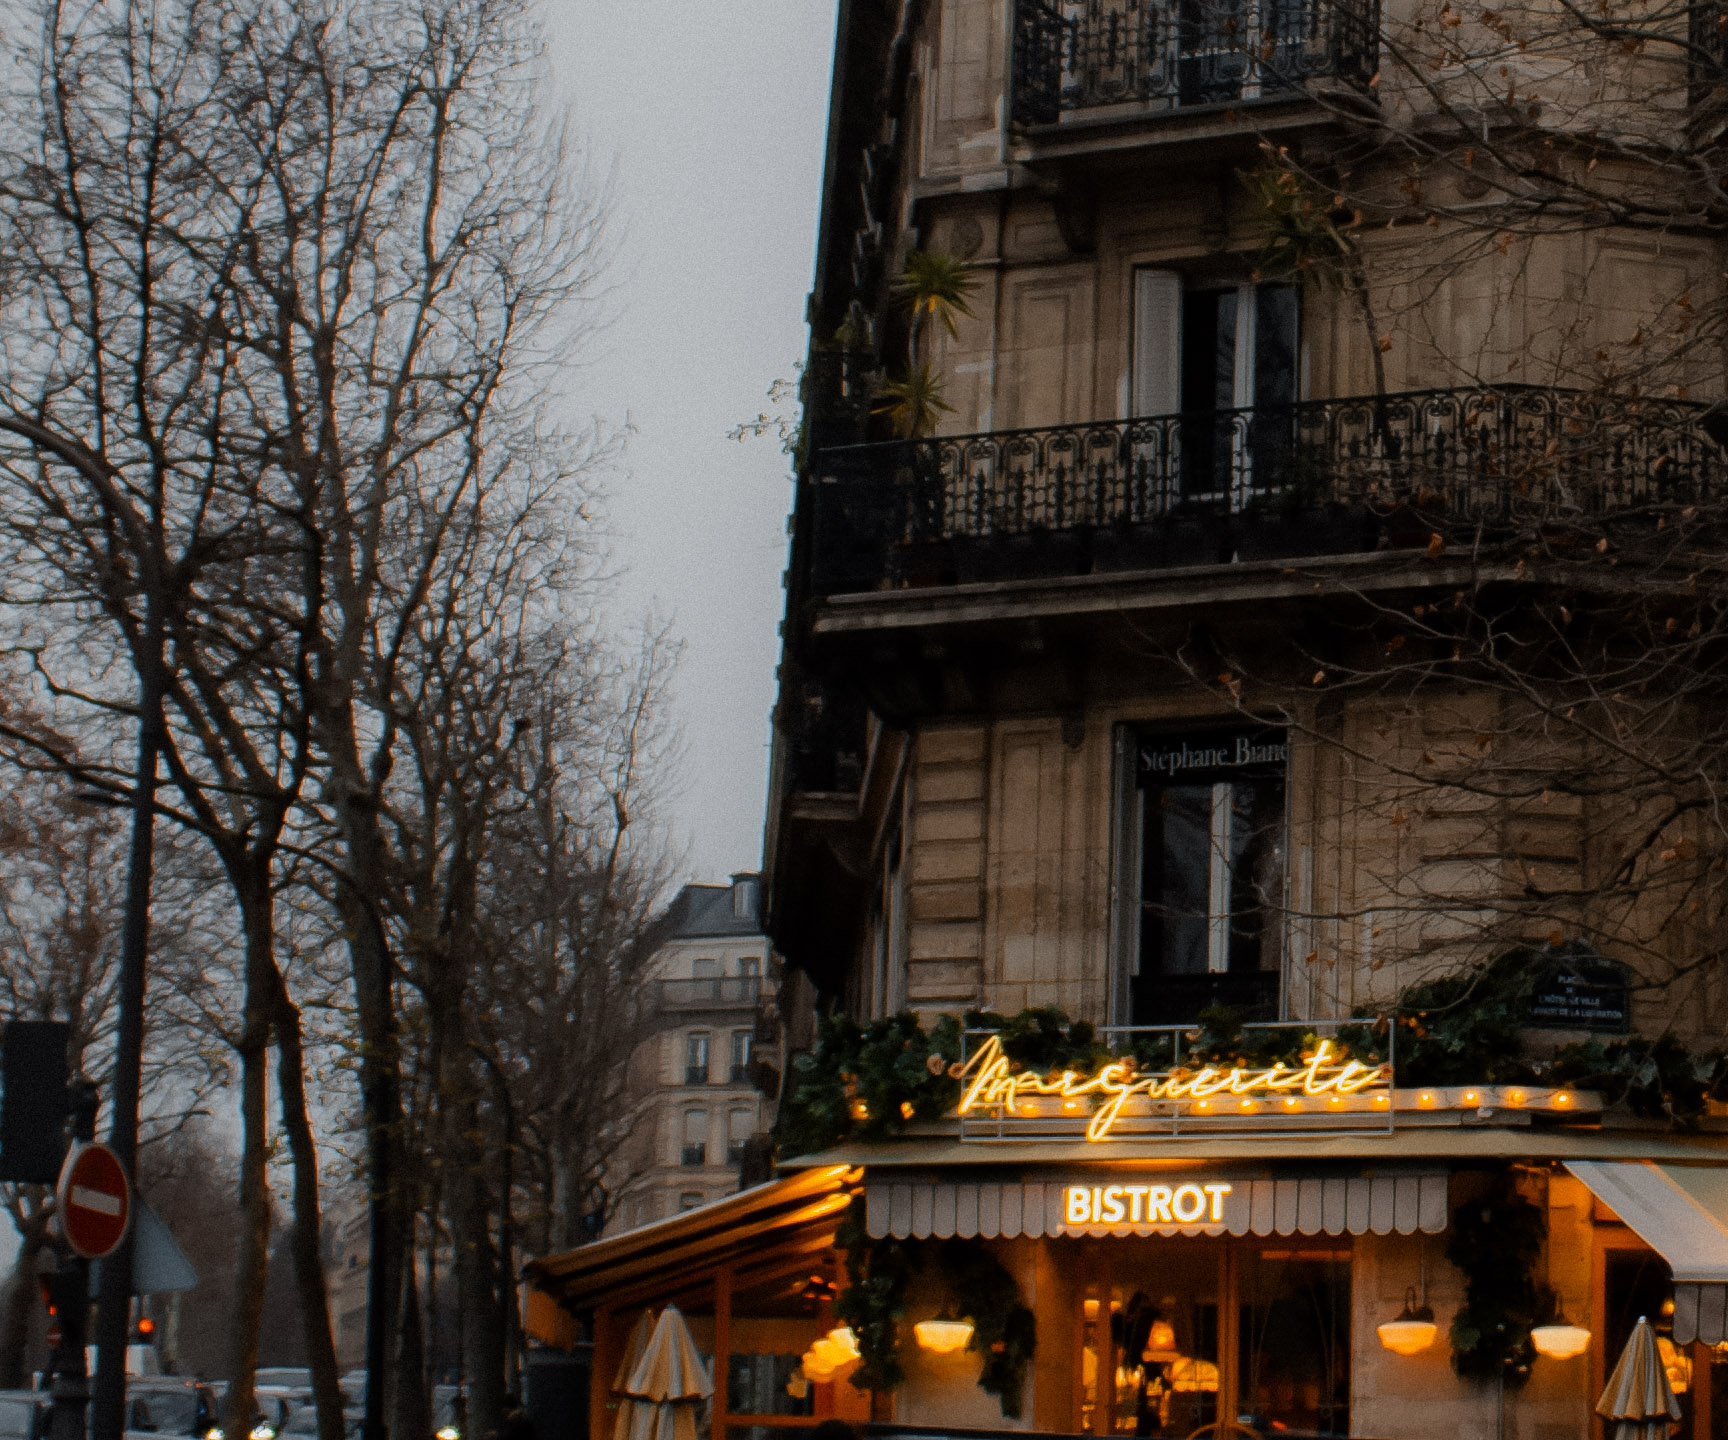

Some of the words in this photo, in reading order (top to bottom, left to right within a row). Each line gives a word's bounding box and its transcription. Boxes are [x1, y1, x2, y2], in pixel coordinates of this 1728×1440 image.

[1139, 742, 1229, 775] Stéphane
[959, 1035, 1381, 1142] Marguerite
[1066, 1184, 1232, 1224] BISTROT
